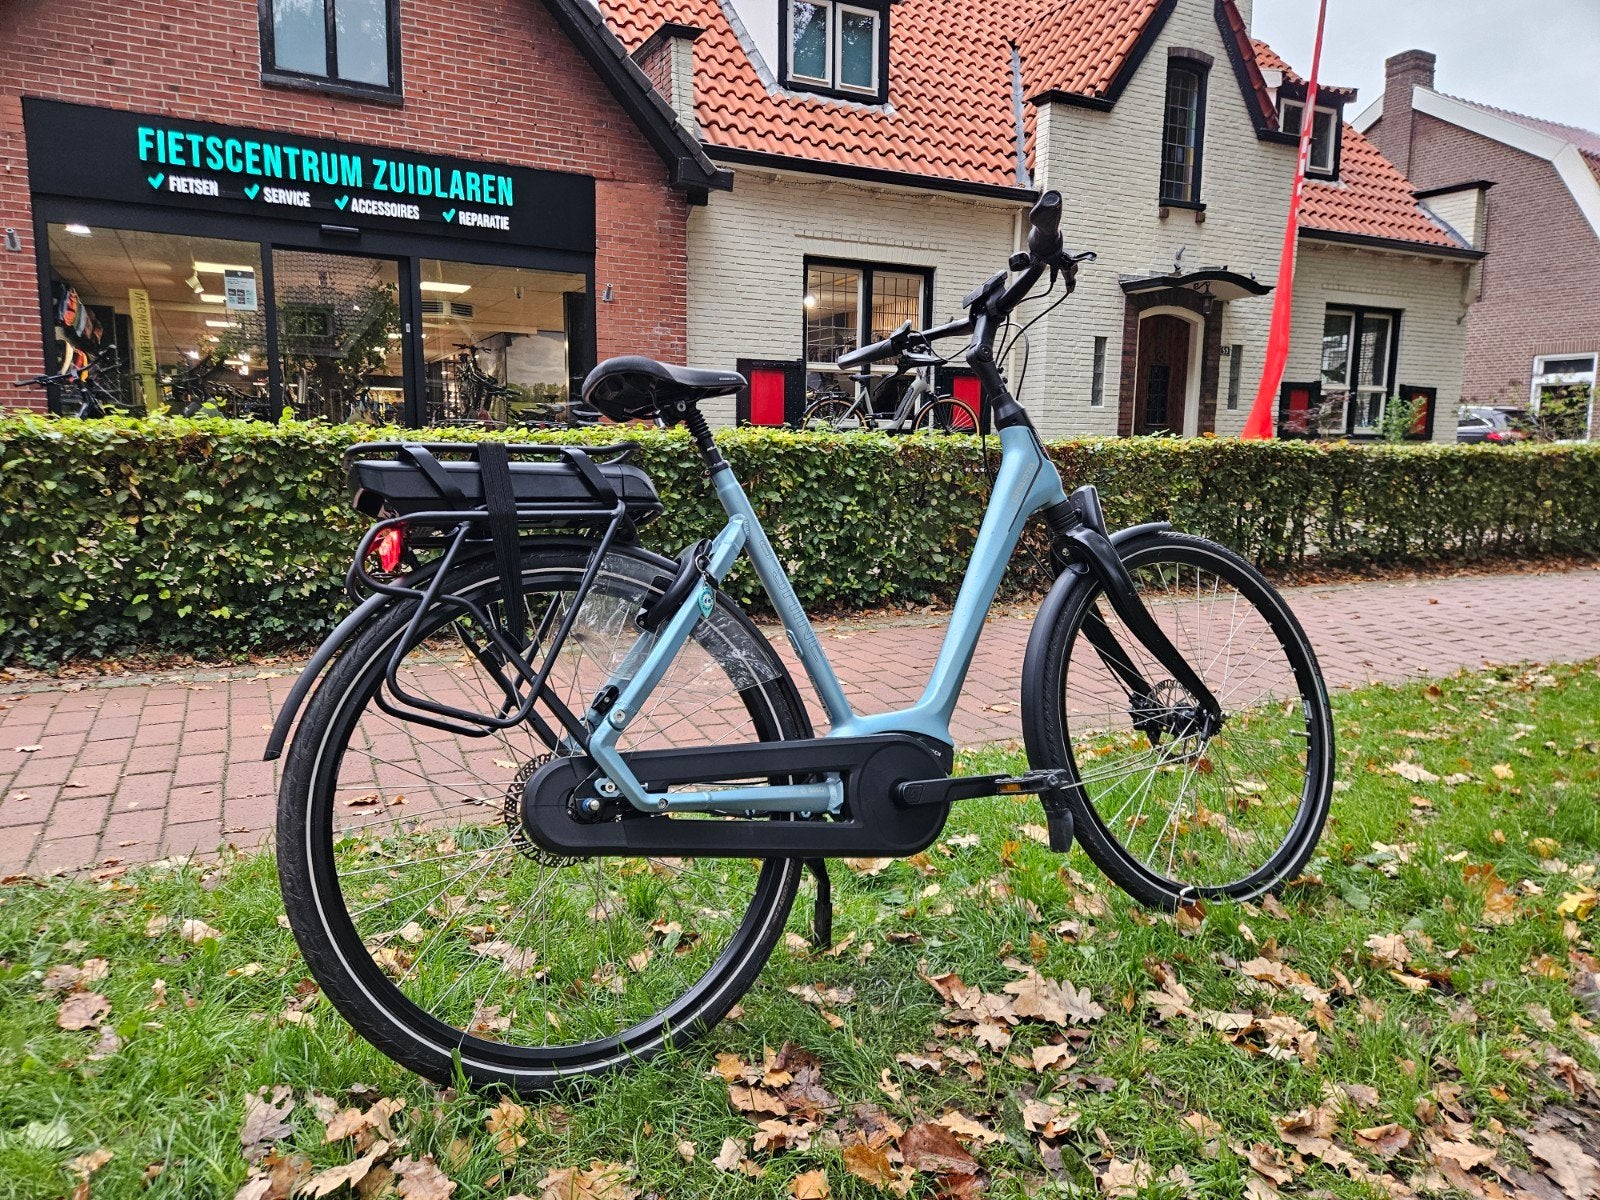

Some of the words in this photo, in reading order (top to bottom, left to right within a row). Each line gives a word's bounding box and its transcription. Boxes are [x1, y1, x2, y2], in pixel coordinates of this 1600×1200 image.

[138, 126, 363, 188] FIETSCENTRUM
[372, 158, 513, 206] ZUIDLAREN
[168, 174, 219, 197] FIETSEN
[263, 186, 312, 208] SERVICE
[351, 197, 420, 220] ACCESSOIRES
[458, 210, 510, 231] REPARATIE
